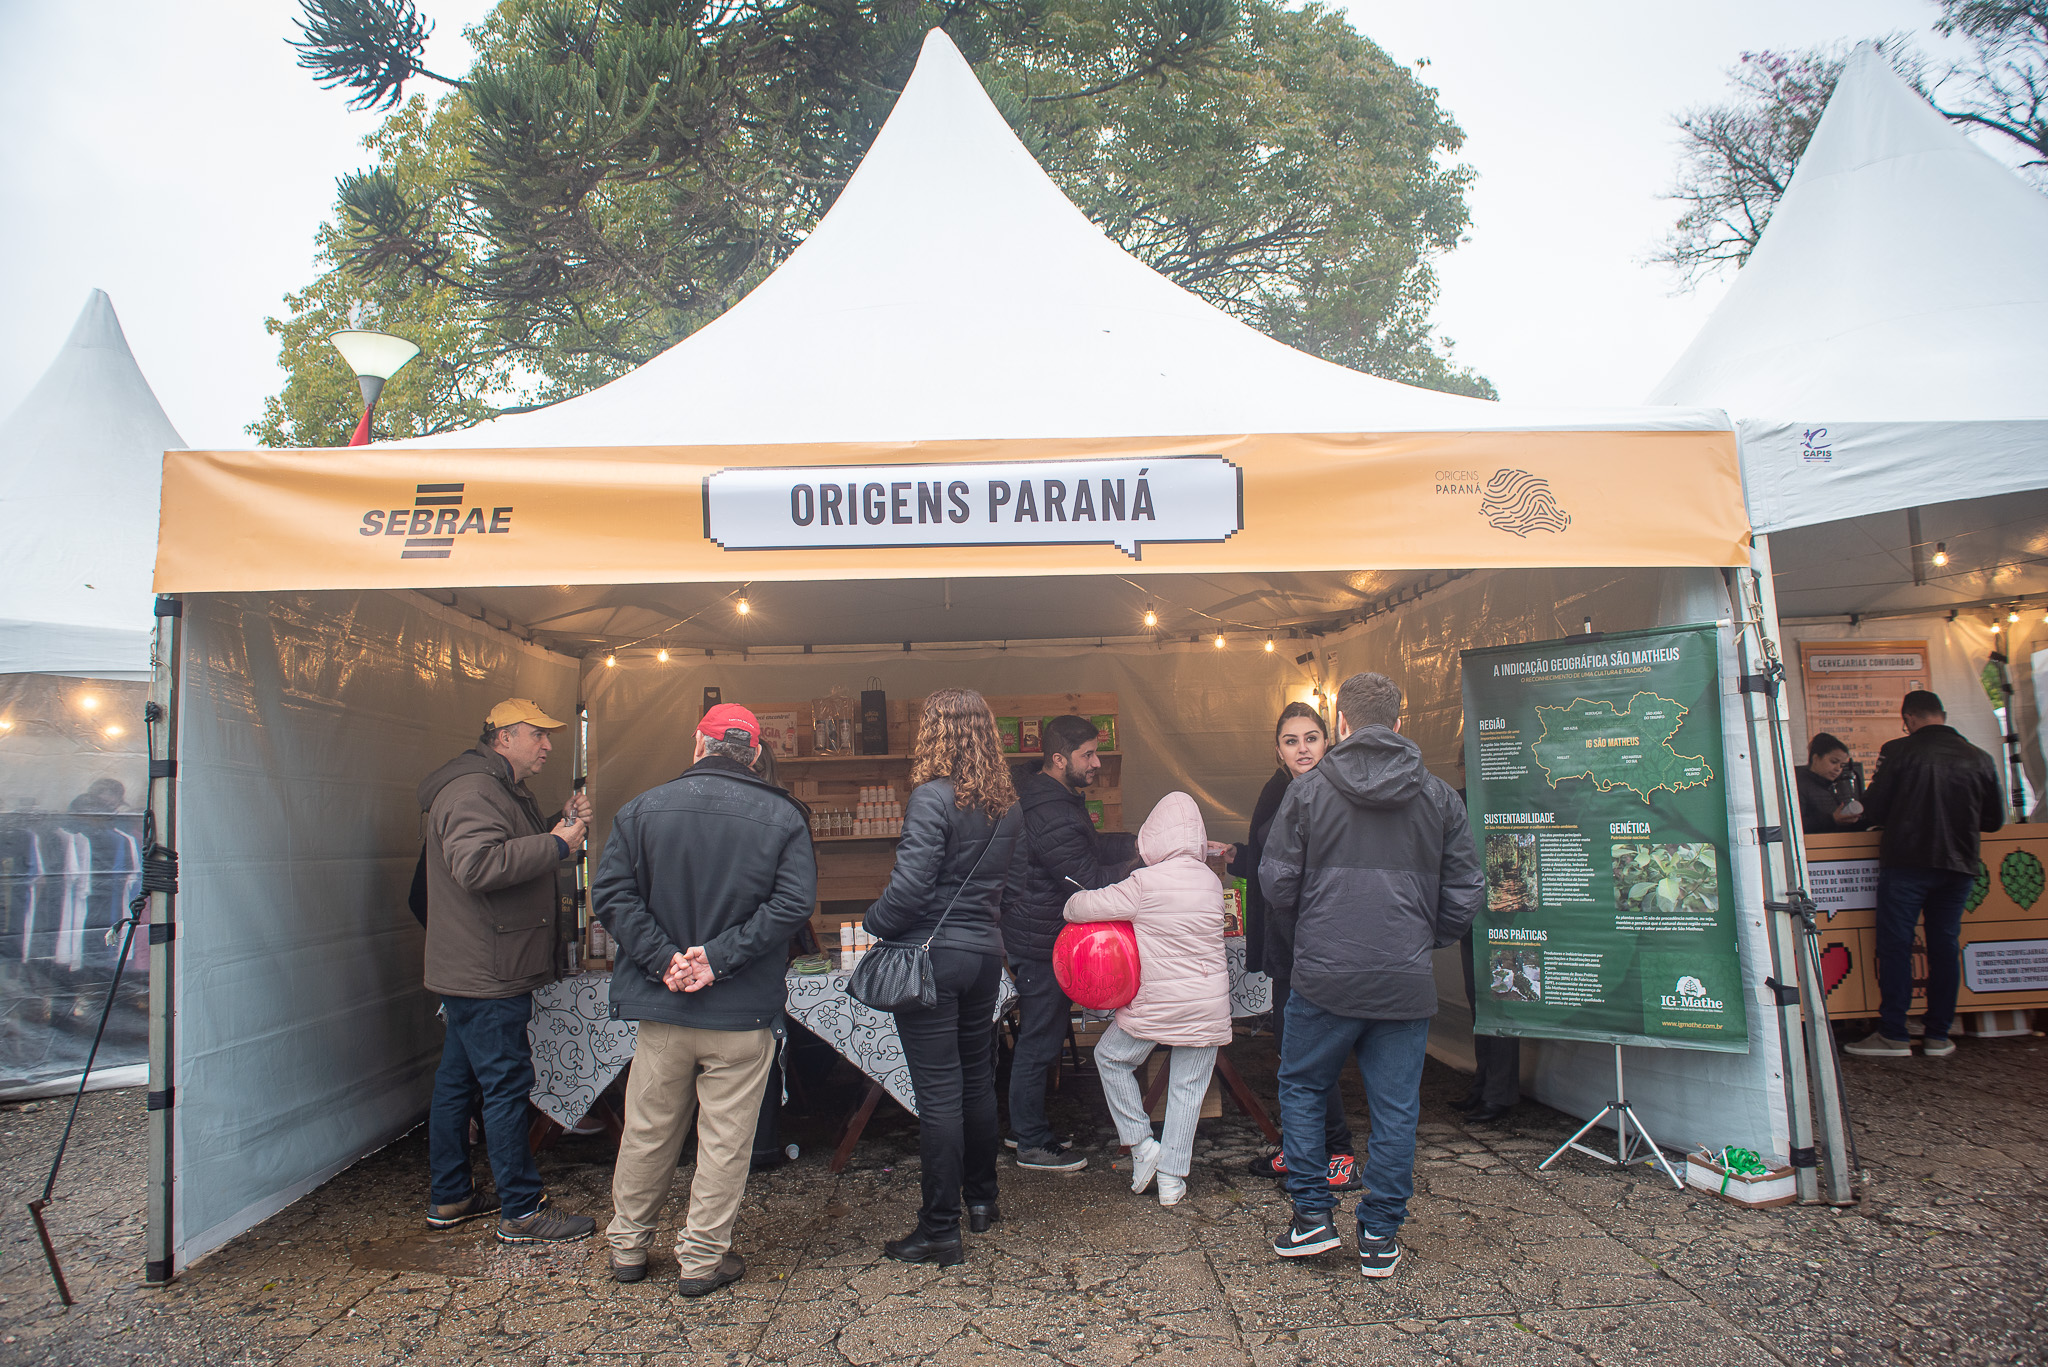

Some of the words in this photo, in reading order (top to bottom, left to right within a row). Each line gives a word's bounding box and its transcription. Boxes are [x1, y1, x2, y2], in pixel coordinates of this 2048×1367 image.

[1435, 471, 1479, 480] ORIGENS
[1436, 482, 1482, 494] PARANÁ
[791, 480, 970, 526] ORIGENS
[988, 468, 1156, 523] PARANÁ
[359, 507, 513, 536] SEBRAE
[1494, 665, 1499, 677] A
[1501, 658, 1548, 675] INDICAÇÃO
[1551, 654, 1608, 672] GEOGRÁFICA
[1610, 651, 1630, 665] SÃO
[1632, 647, 1680, 663] MATHEUS
[1818, 659, 1867, 668] CERVEJARIAS
[1526, 674, 1572, 682] RECONHECIMENTO
[1480, 717, 1506, 730] REGIÃO
[1586, 740, 1592, 748] IG
[1593, 737, 1606, 748] SÃO
[1608, 737, 1640, 746] MATHEUS
[1484, 813, 1555, 824] SUSTENTABILIDADE
[1610, 821, 1651, 834] GENÉTICA
[1488, 929, 1508, 939] BOAS
[1510, 928, 1548, 940] PRÁTICAS
[1661, 995, 1723, 1009] IG-Mathe
[1662, 1021, 1723, 1029] www.igmathe.com.br
